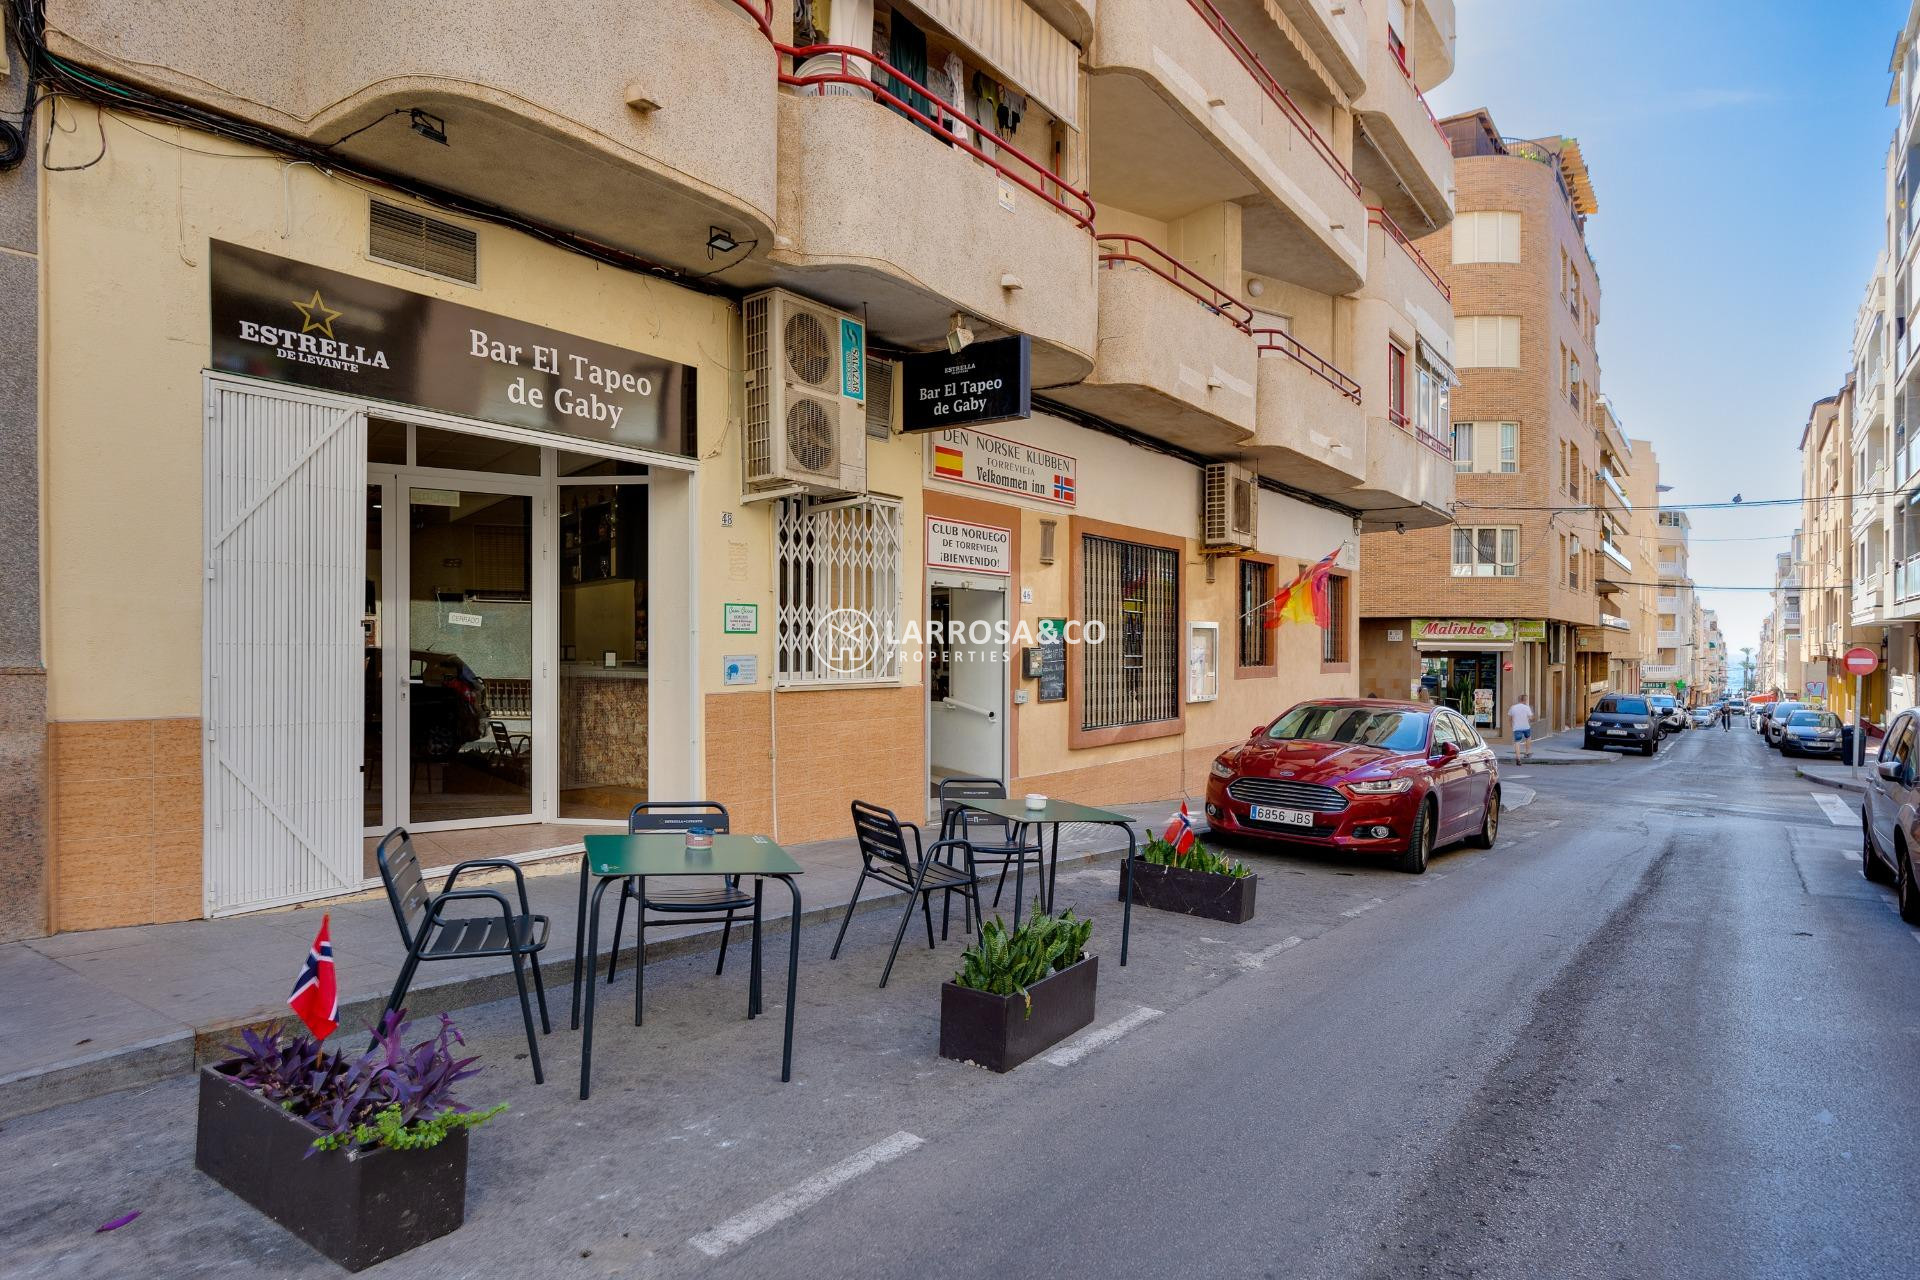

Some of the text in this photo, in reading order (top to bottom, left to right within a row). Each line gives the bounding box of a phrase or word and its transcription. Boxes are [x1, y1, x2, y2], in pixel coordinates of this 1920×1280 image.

[239, 320, 390, 370] ESTRELLA
[276, 347, 360, 374] DE LEVANTE
[469, 329, 653, 396] Bar El Tapeo
[851, 348, 860, 393] SALAZAR
[944, 363, 976, 374] ESTRELLA
[919, 378, 1003, 401] Bar El Tapeo
[507, 377, 624, 429] de Gaby
[933, 396, 987, 416] de Gaby
[943, 428, 1070, 472] DEN NORSKE KLUBBEN
[976, 465, 1045, 495] Velkommen inn
[932, 523, 1007, 543] CLUB NORUEGO
[942, 538, 998, 554] DE TORREVIEJA
[940, 552, 1000, 568] ¡BIENVENIDO!
[1420, 621, 1487, 636] Malinka
[1257, 808, 1311, 825] 6856 JBS
